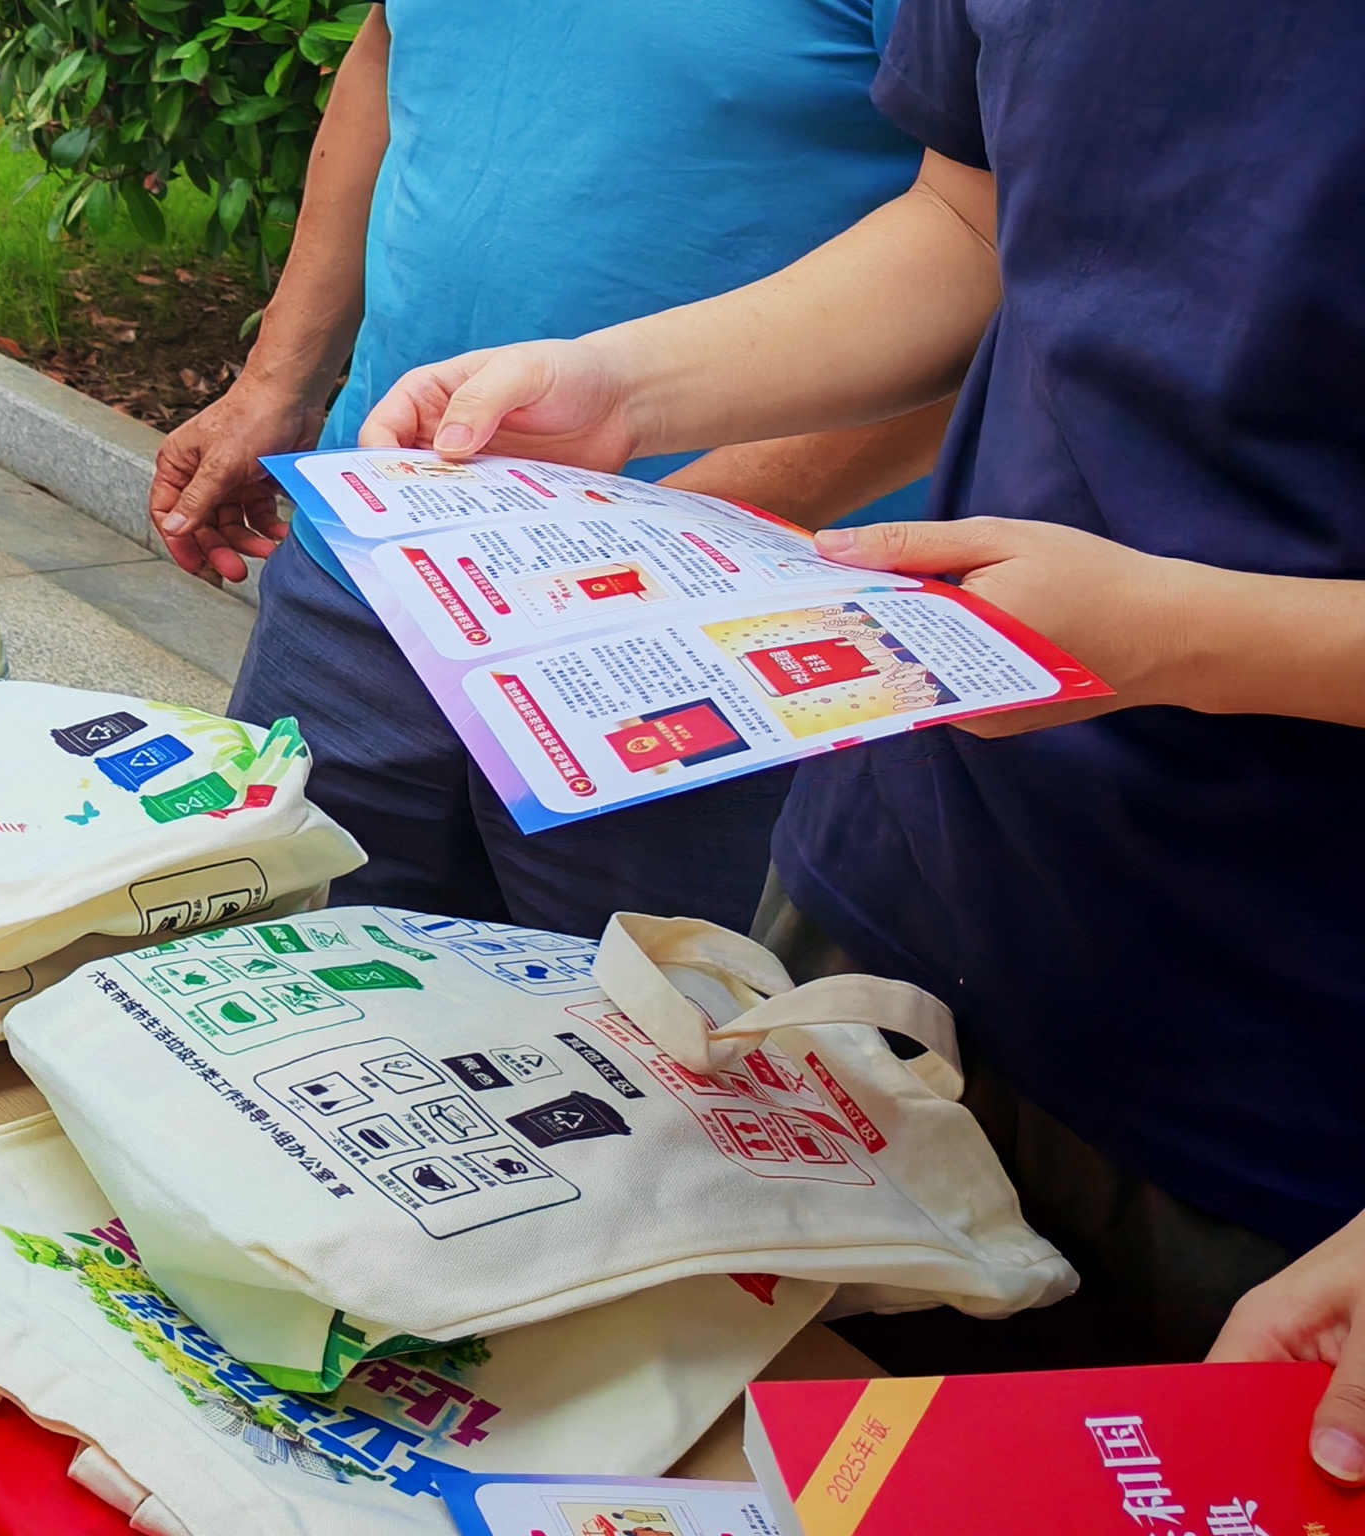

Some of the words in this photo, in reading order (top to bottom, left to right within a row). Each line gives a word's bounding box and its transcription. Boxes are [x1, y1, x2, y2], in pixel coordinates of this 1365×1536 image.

[85, 968, 340, 1184] 六安市城市生活垃圾分类工作领导小组办公室
[327, 1182, 356, 1201] 宣
[460, 1056, 495, 1087] 黑色
[564, 1034, 639, 1098] 其他垃圾
[812, 1058, 880, 1145] 有害垃圾
[326, 1129, 371, 1166] 一次性餐具
[825, 1414, 893, 1505] 2025年版
[1084, 1414, 1197, 1536] 和国
